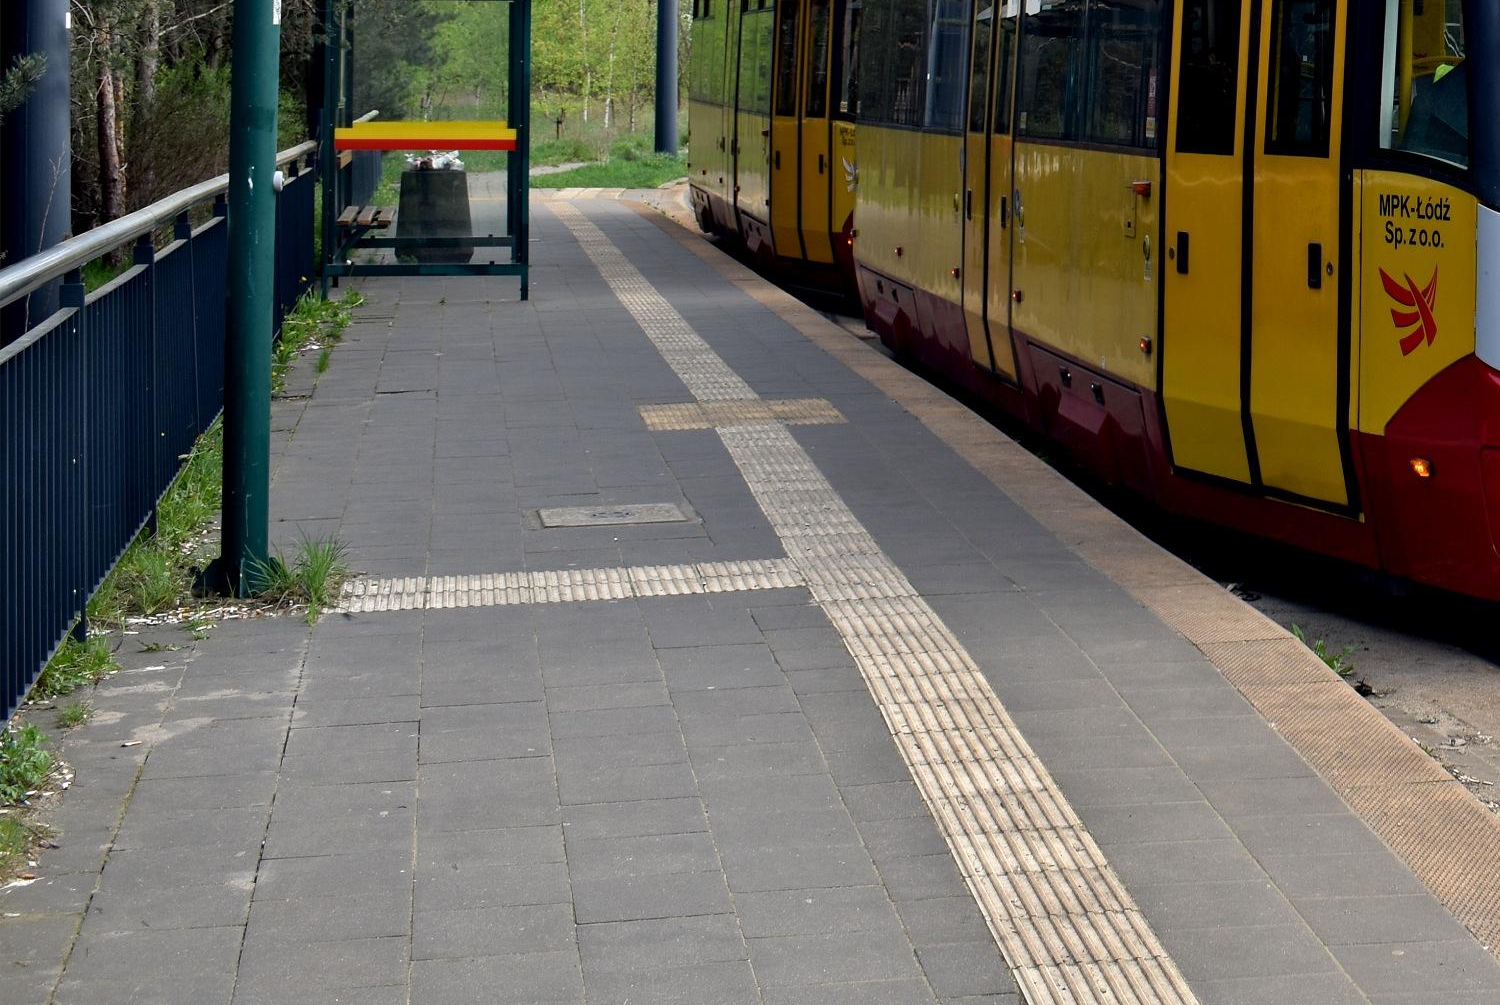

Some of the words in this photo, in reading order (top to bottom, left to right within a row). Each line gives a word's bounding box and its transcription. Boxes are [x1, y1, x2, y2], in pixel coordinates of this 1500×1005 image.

[1379, 194, 1451, 221] MPK-Łódź
[1385, 220, 1407, 250] Sp.
[1418, 229, 1445, 249] o.o.
